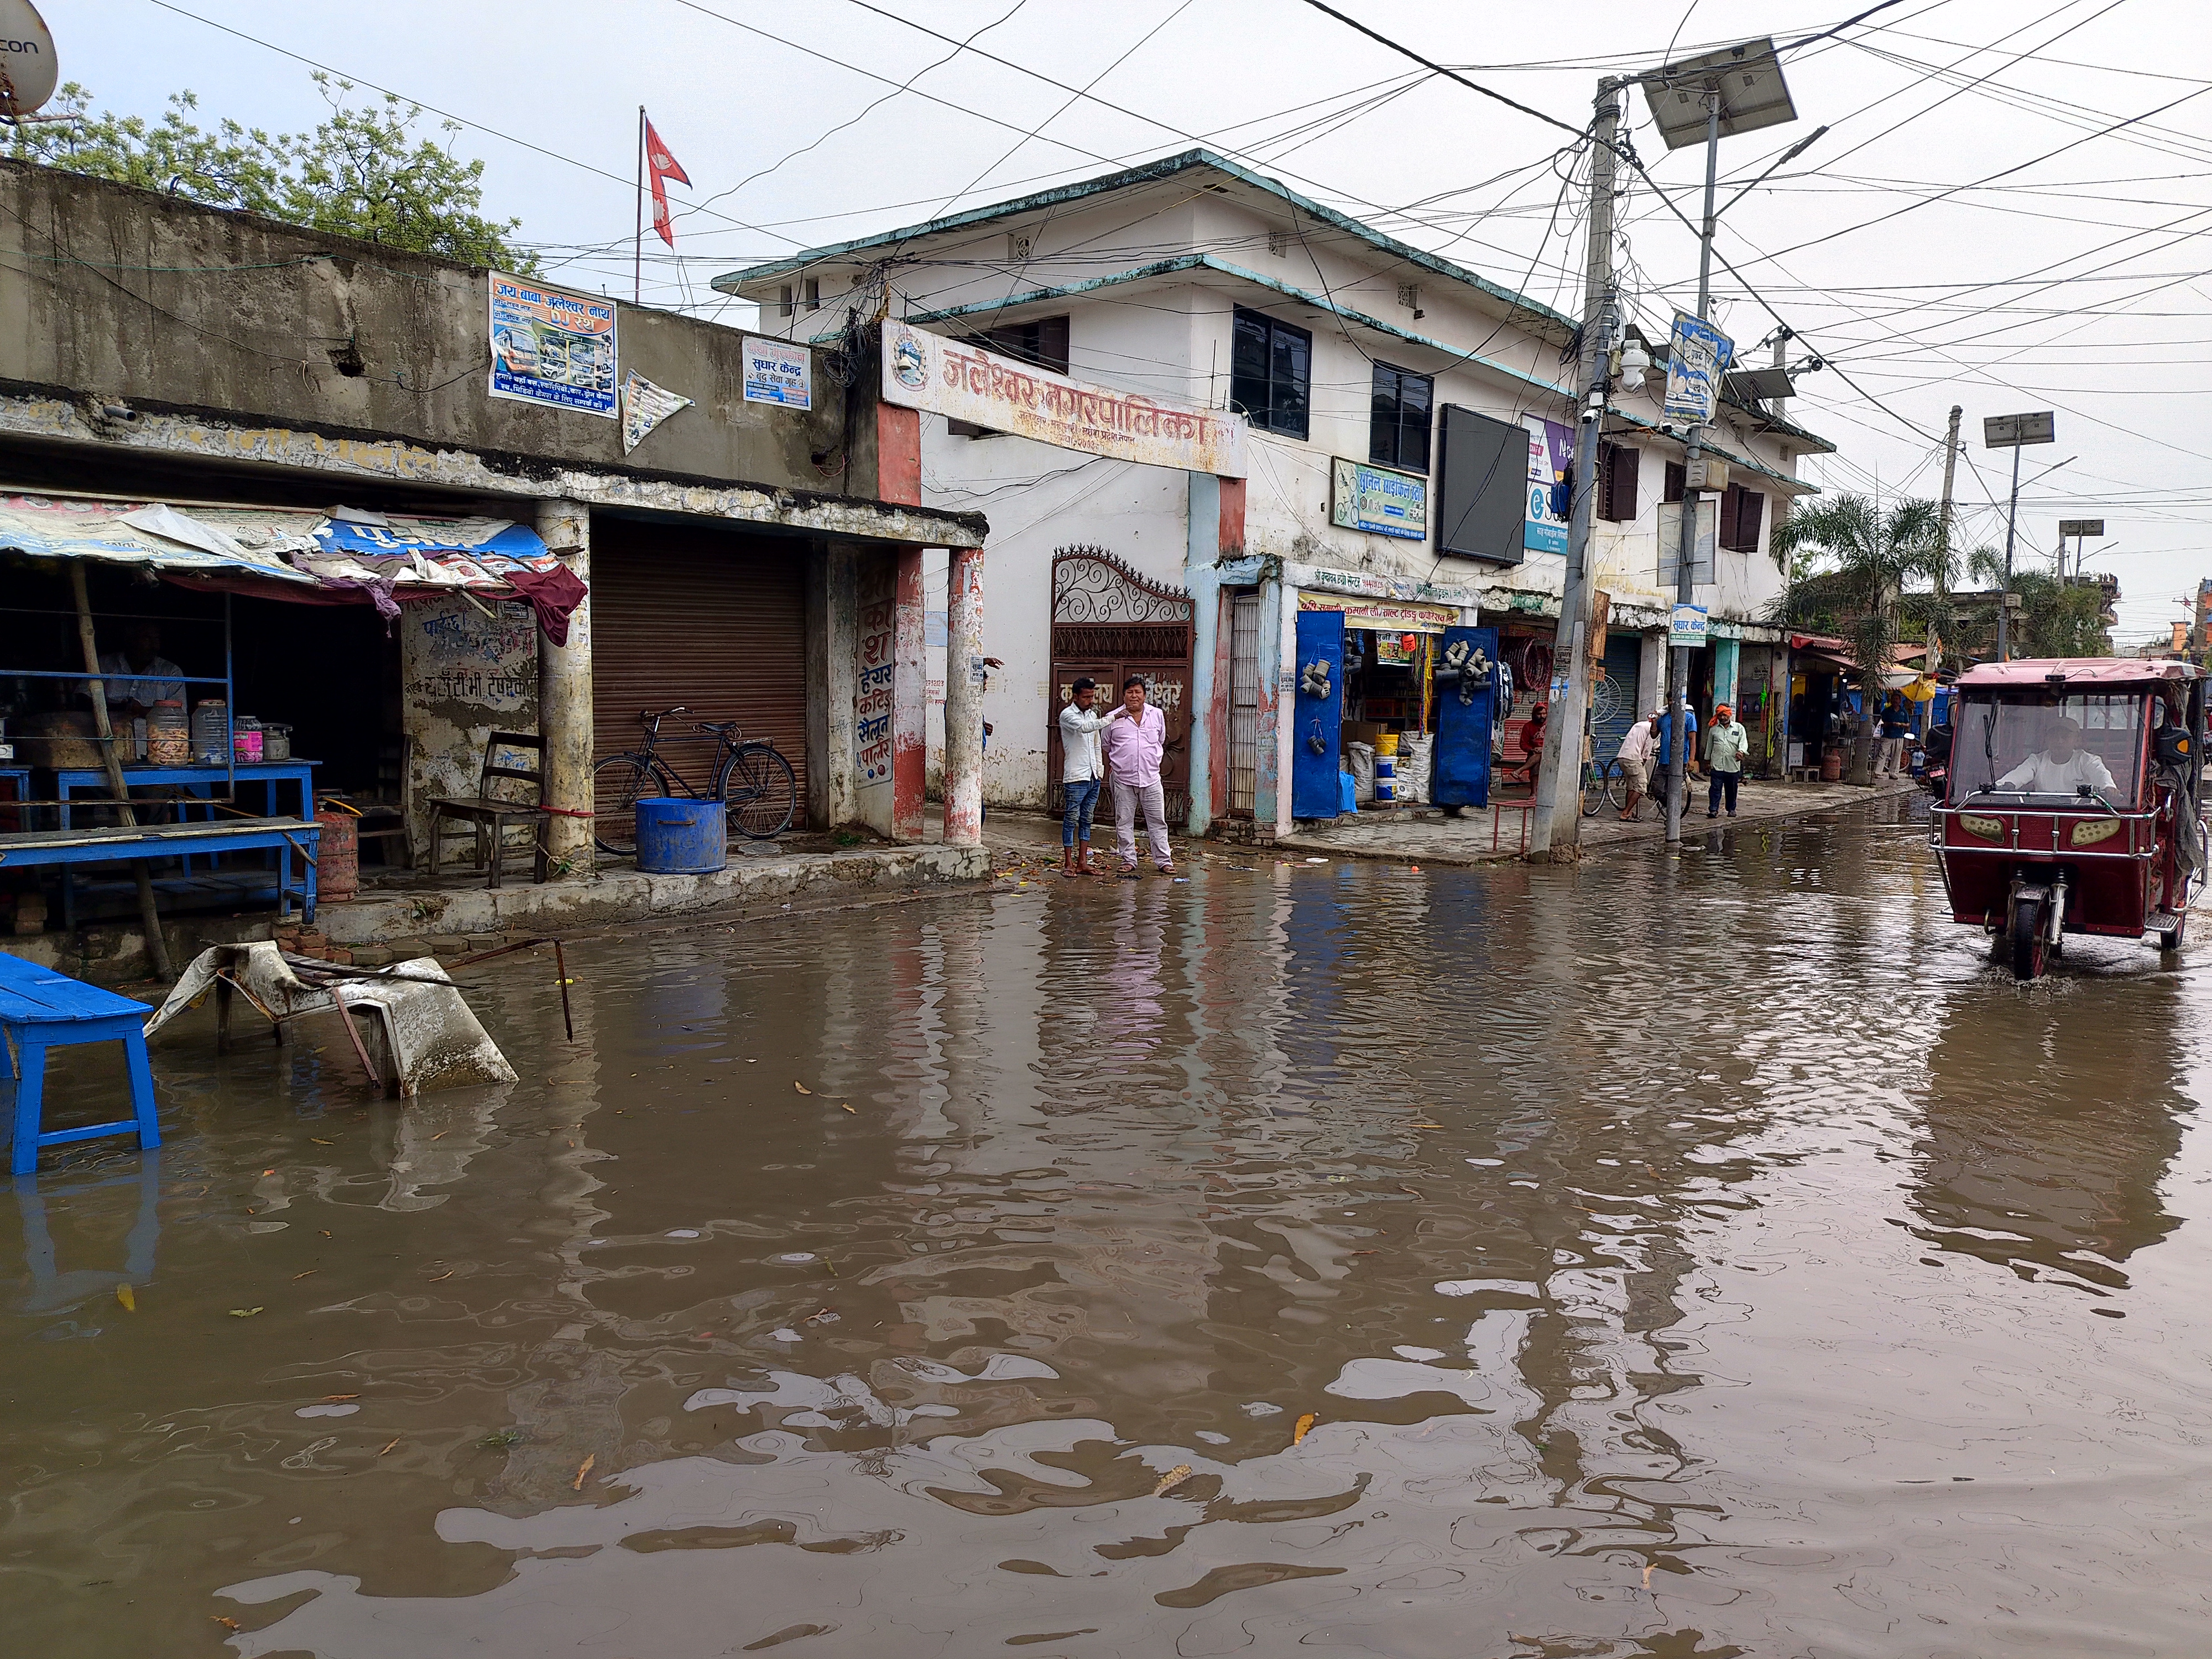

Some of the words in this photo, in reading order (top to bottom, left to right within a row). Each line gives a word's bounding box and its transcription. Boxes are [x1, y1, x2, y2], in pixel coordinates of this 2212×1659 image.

[497, 283, 517, 298] जय
[520, 289, 541, 304] बाबा
[545, 295, 585, 315] जलेश्वर
[588, 305, 611, 320] नाथ
[551, 309, 570, 326] DJ
[575, 316, 595, 332] रथ
[496, 372, 512, 381] हमारे
[752, 358, 778, 372] सुधार
[780, 362, 802, 377] केन्द्र
[769, 373, 783, 384] सेवा
[785, 377, 797, 388] गृह
[561, 394, 573, 405] लिए
[942, 349, 1040, 410] जलेश्वर
[1045, 382, 1209, 445] नगरपालिका
[1359, 469, 1381, 494] सुनिल
[1347, 573, 1360, 588] सेन्टर
[1673, 620, 1689, 632] सुधार
[1691, 618, 1705, 632] केन्द्र
[859, 663, 892, 695] हेयर
